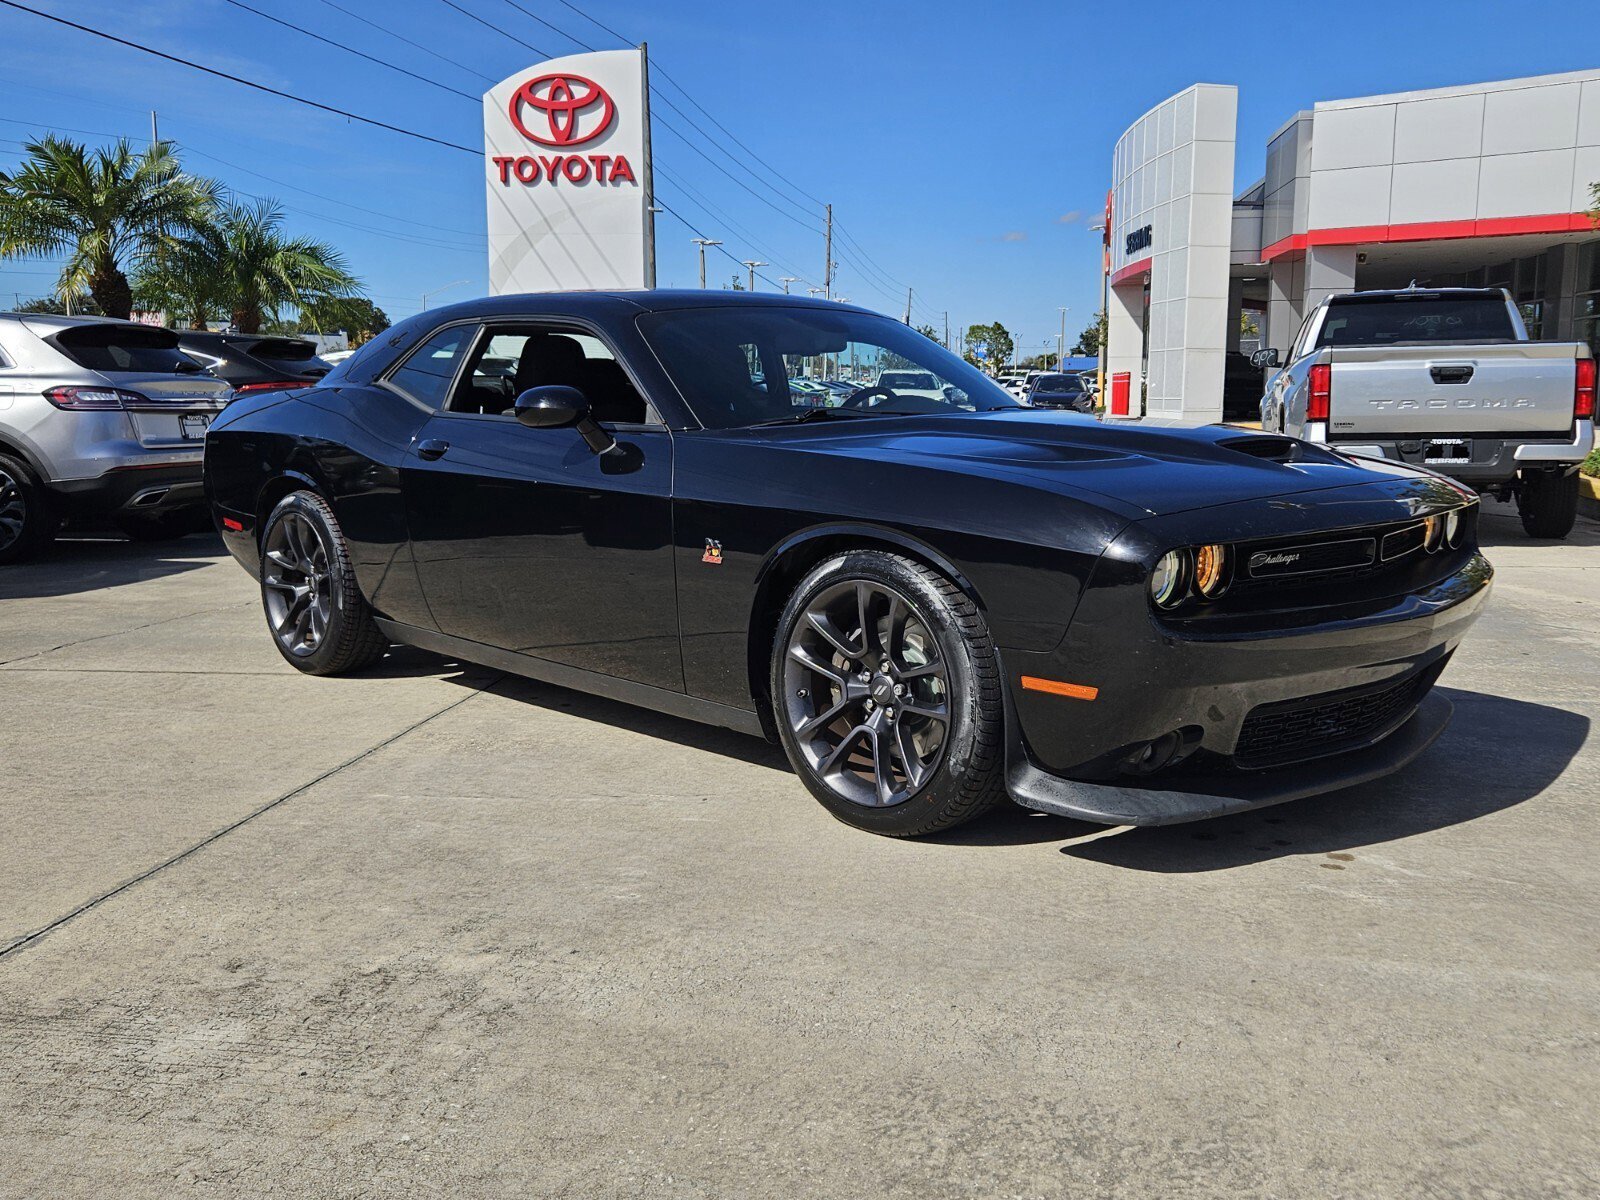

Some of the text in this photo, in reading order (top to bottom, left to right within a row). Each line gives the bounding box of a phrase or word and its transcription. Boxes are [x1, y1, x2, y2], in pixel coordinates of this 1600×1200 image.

[492, 154, 636, 184] TOYOTA
[1369, 398, 1536, 410] TACOMA
[1250, 553, 1300, 567] Challenger
